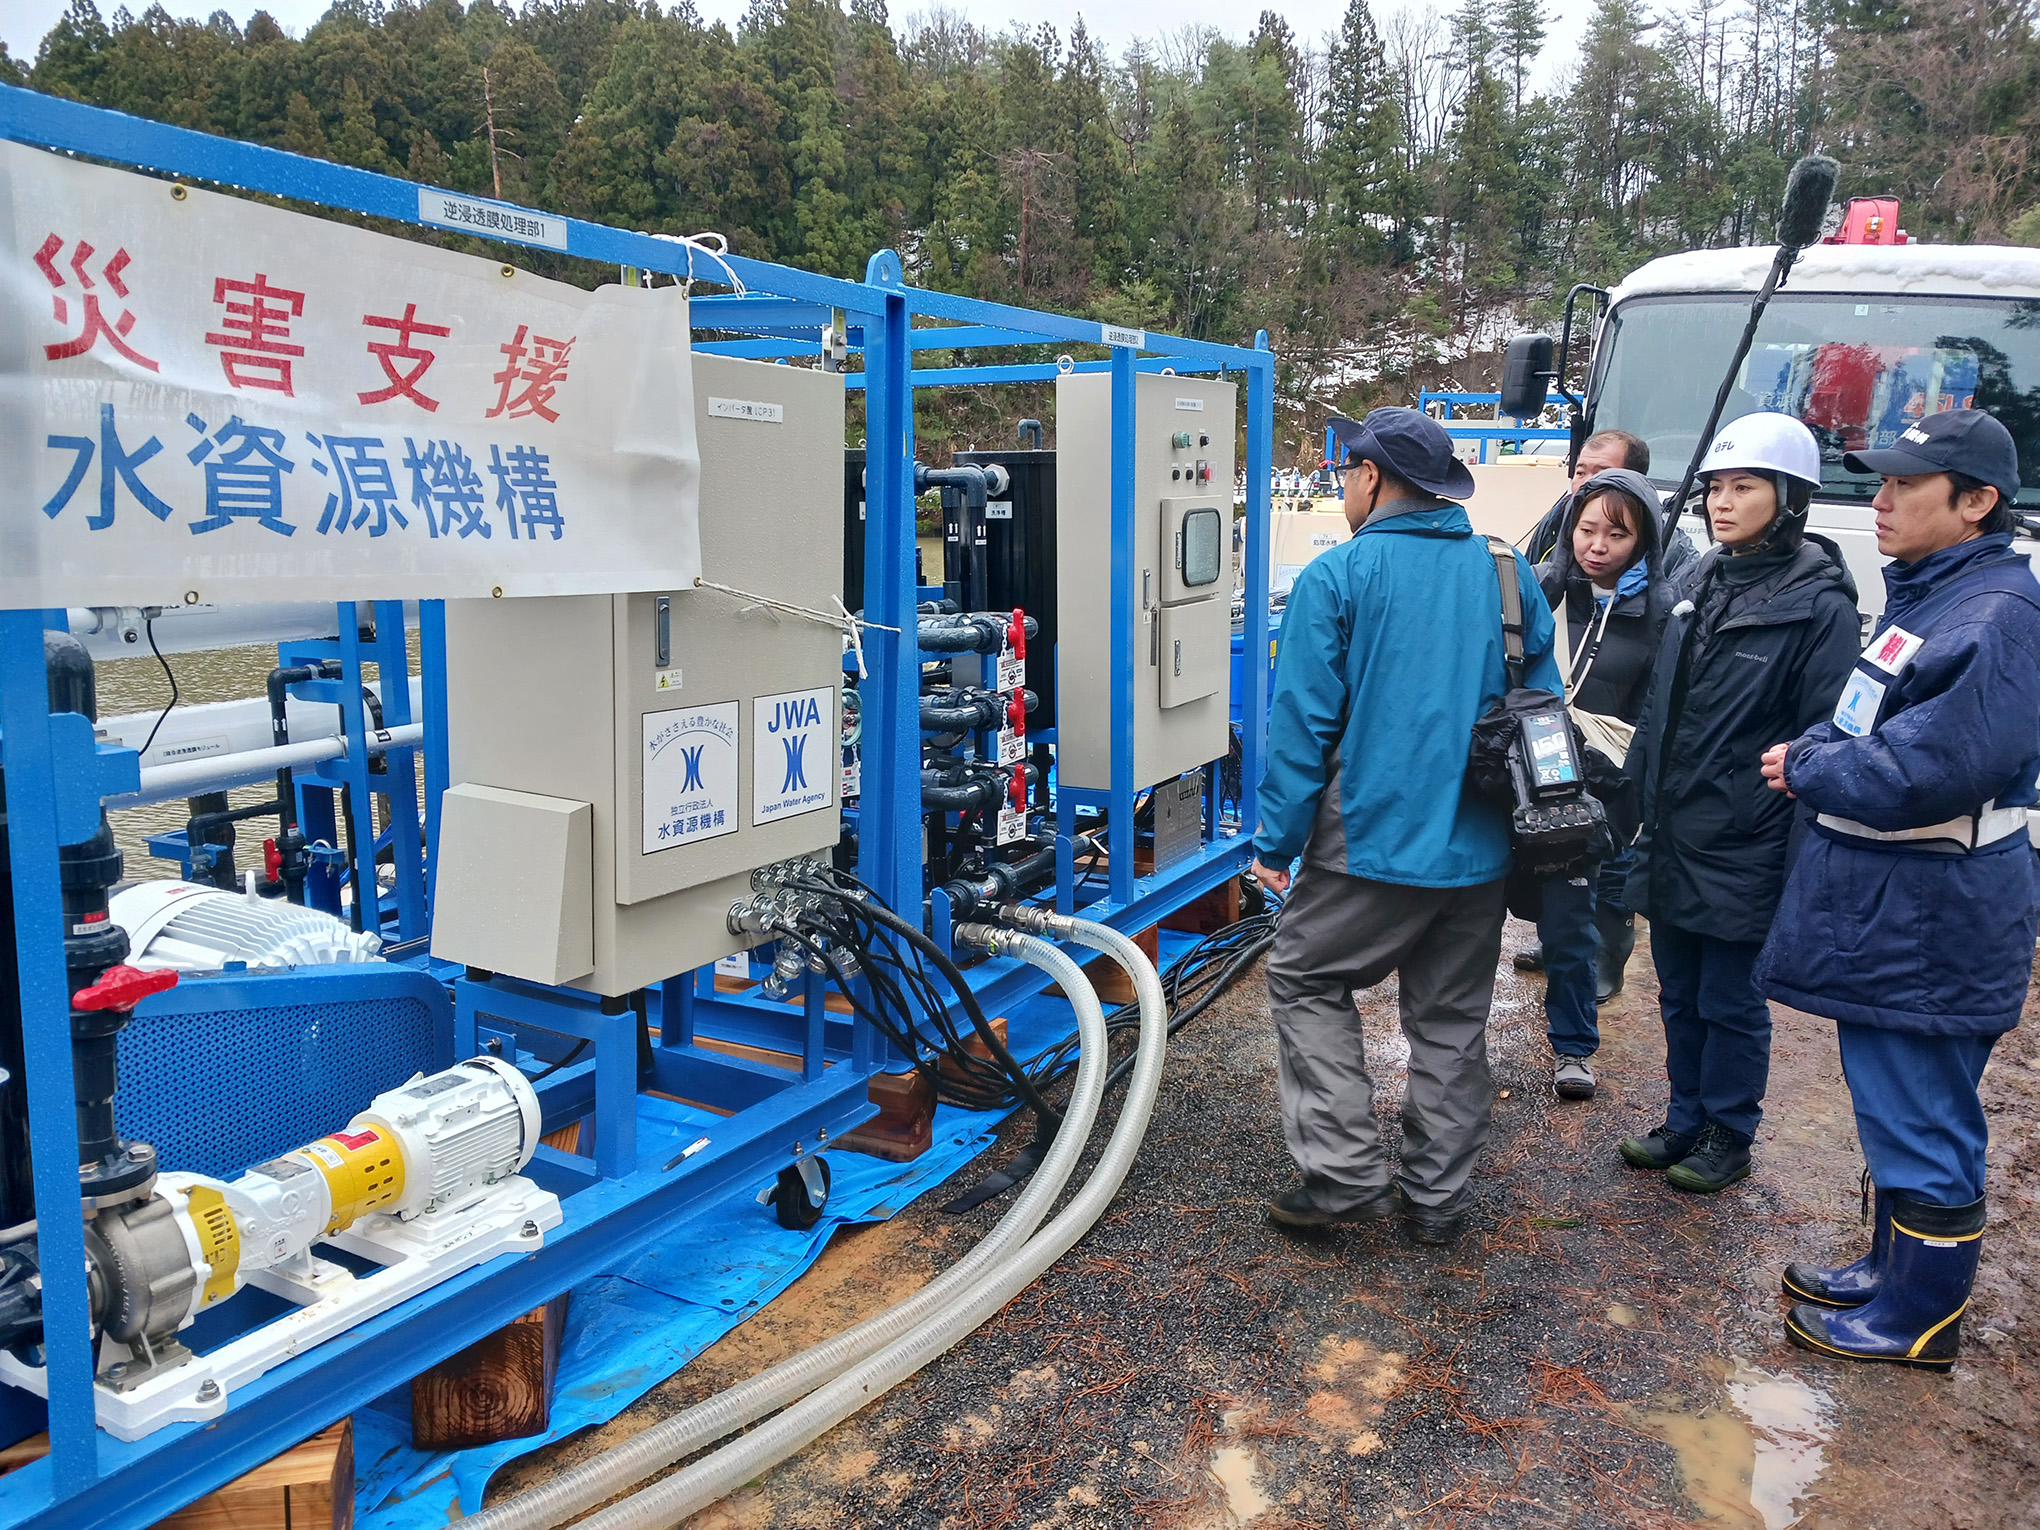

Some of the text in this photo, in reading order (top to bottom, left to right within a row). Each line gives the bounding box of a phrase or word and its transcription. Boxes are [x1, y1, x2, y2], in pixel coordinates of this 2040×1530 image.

[443, 200, 545, 238] 逆浸透膜処理部1
[33, 232, 577, 426] 災害支援
[42, 402, 566, 540] 水資源機構
[768, 697, 821, 733] JWA
[649, 716, 734, 751] 水がささえる豊かな社会
[671, 798, 714, 816] 独立行政法人
[761, 792, 825, 814] Japan Water Agency
[657, 809, 725, 840] 水資源機構
